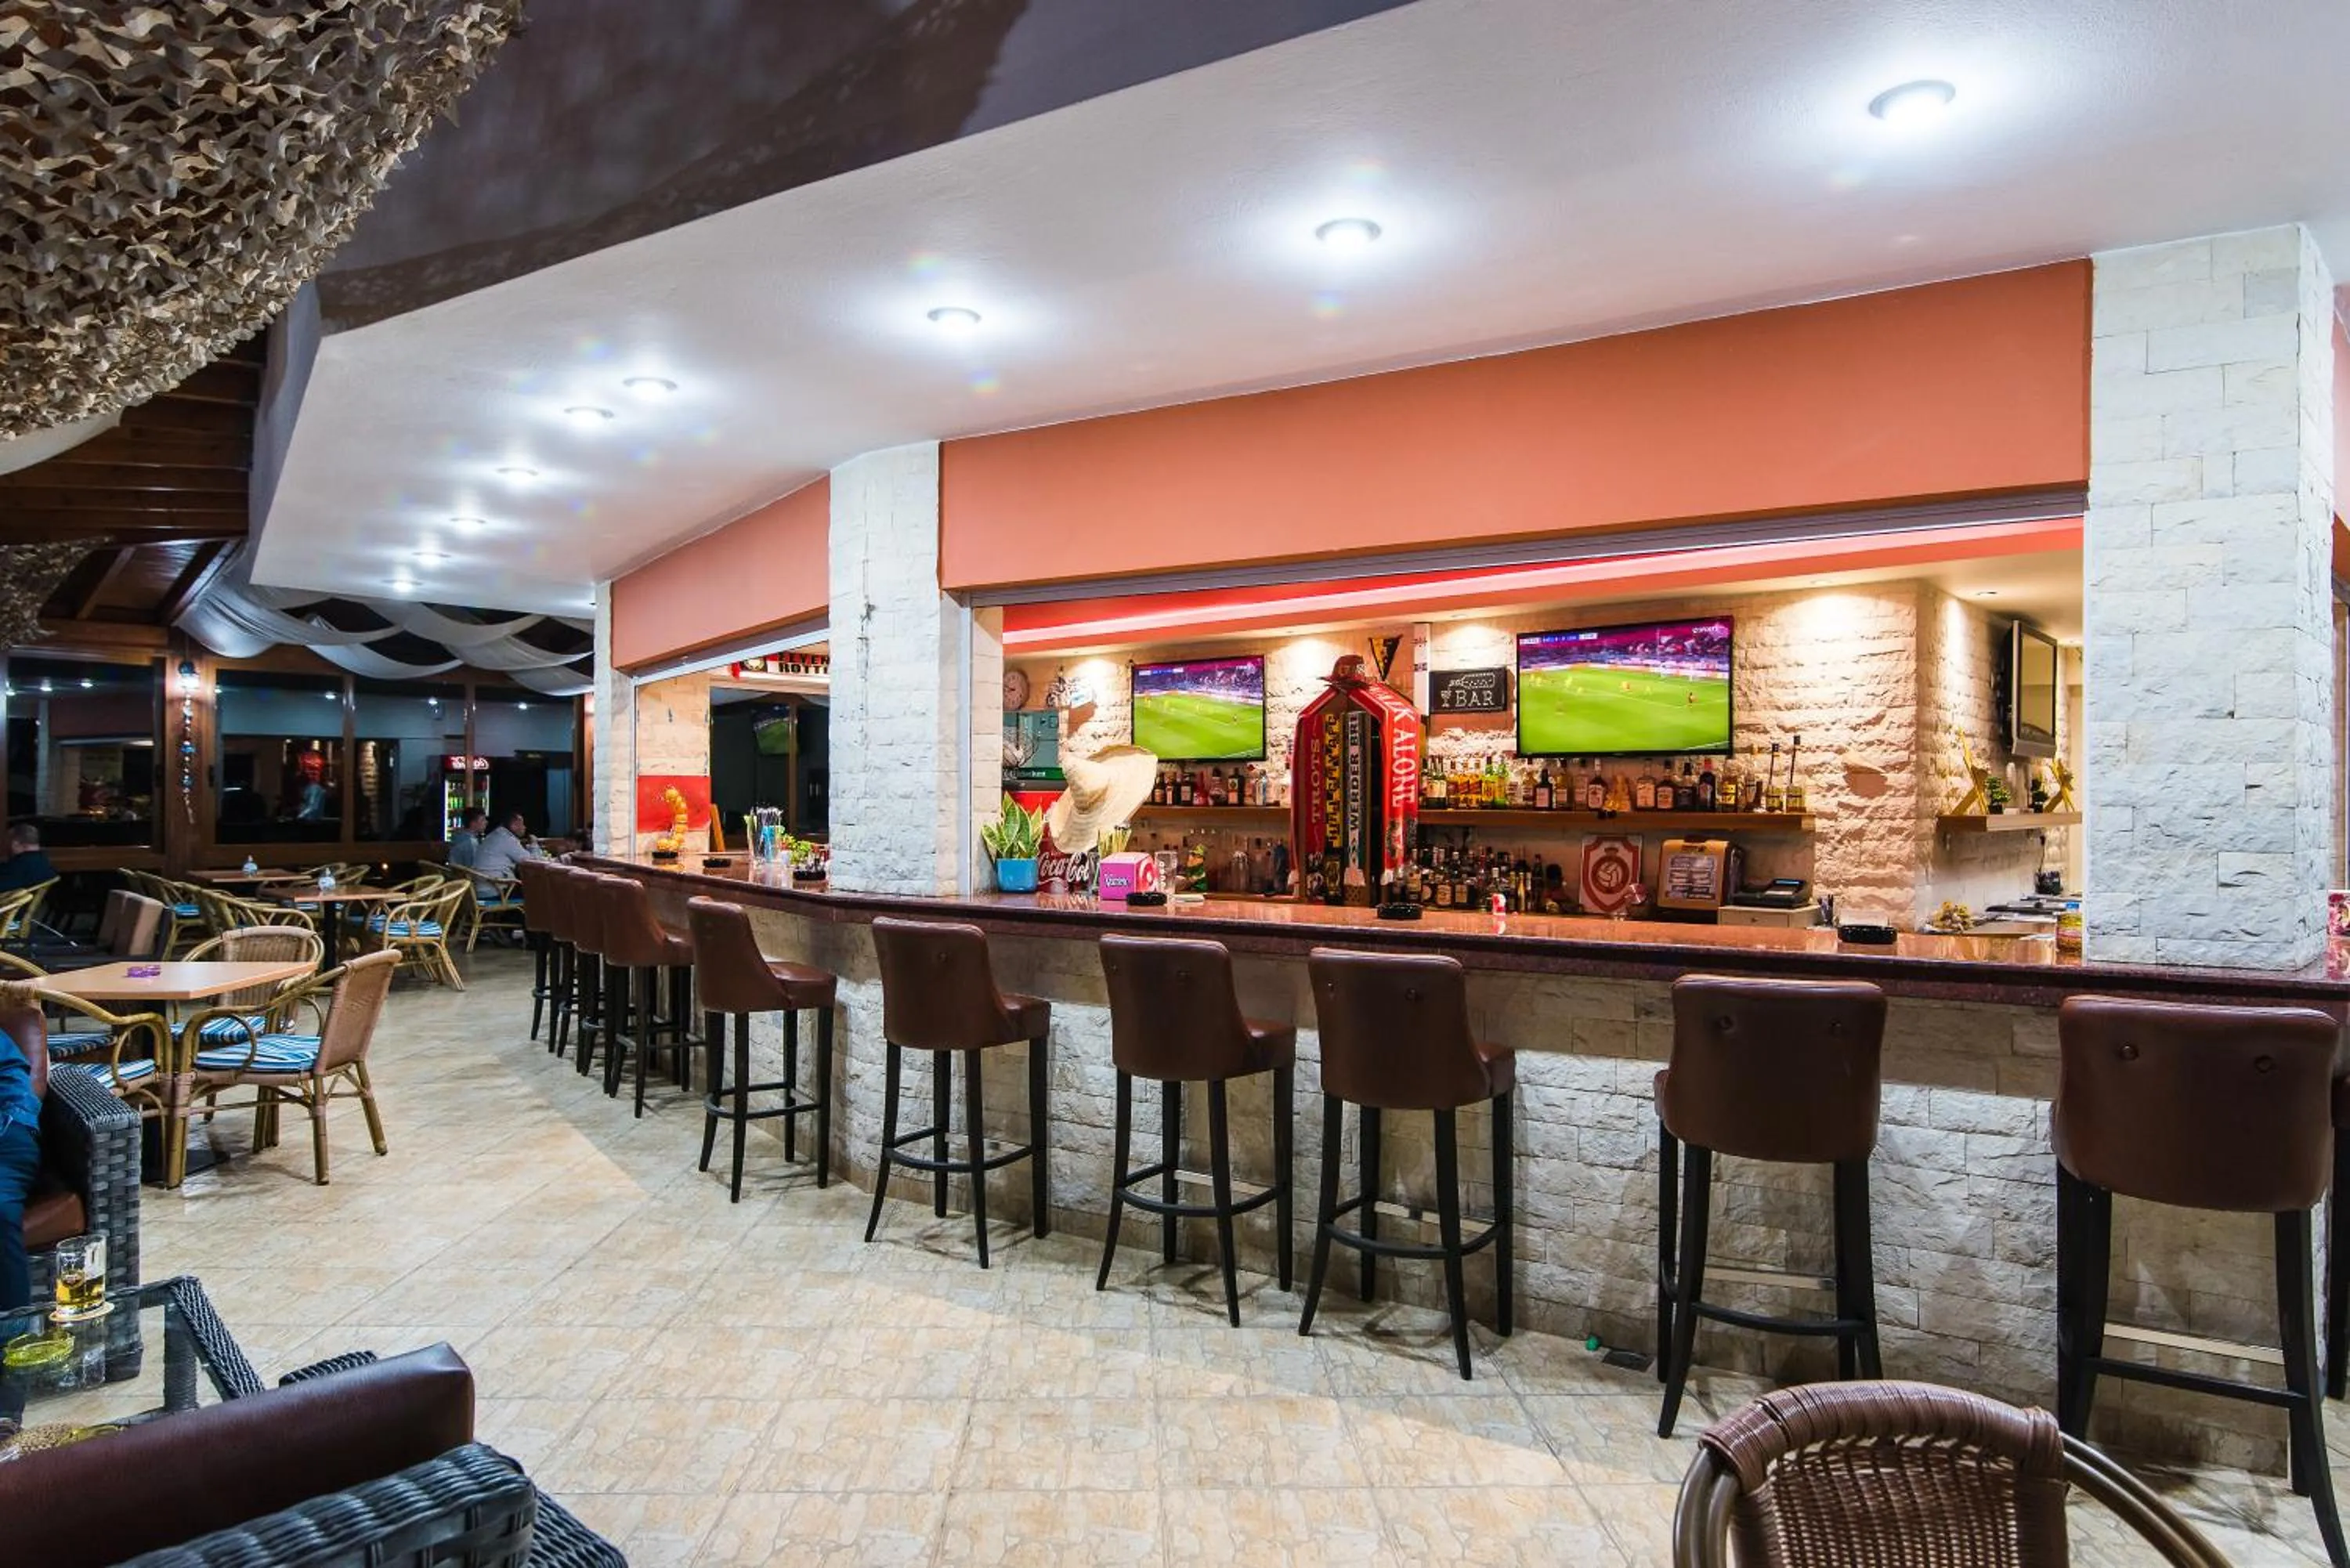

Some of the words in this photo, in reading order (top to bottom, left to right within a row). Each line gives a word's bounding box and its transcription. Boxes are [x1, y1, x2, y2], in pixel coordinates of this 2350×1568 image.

[1455, 690, 1495, 707] BAR
[1311, 739, 1320, 823] TROTS
[1350, 753, 1359, 831] WERDER
[1392, 728, 1417, 807] ALONE
